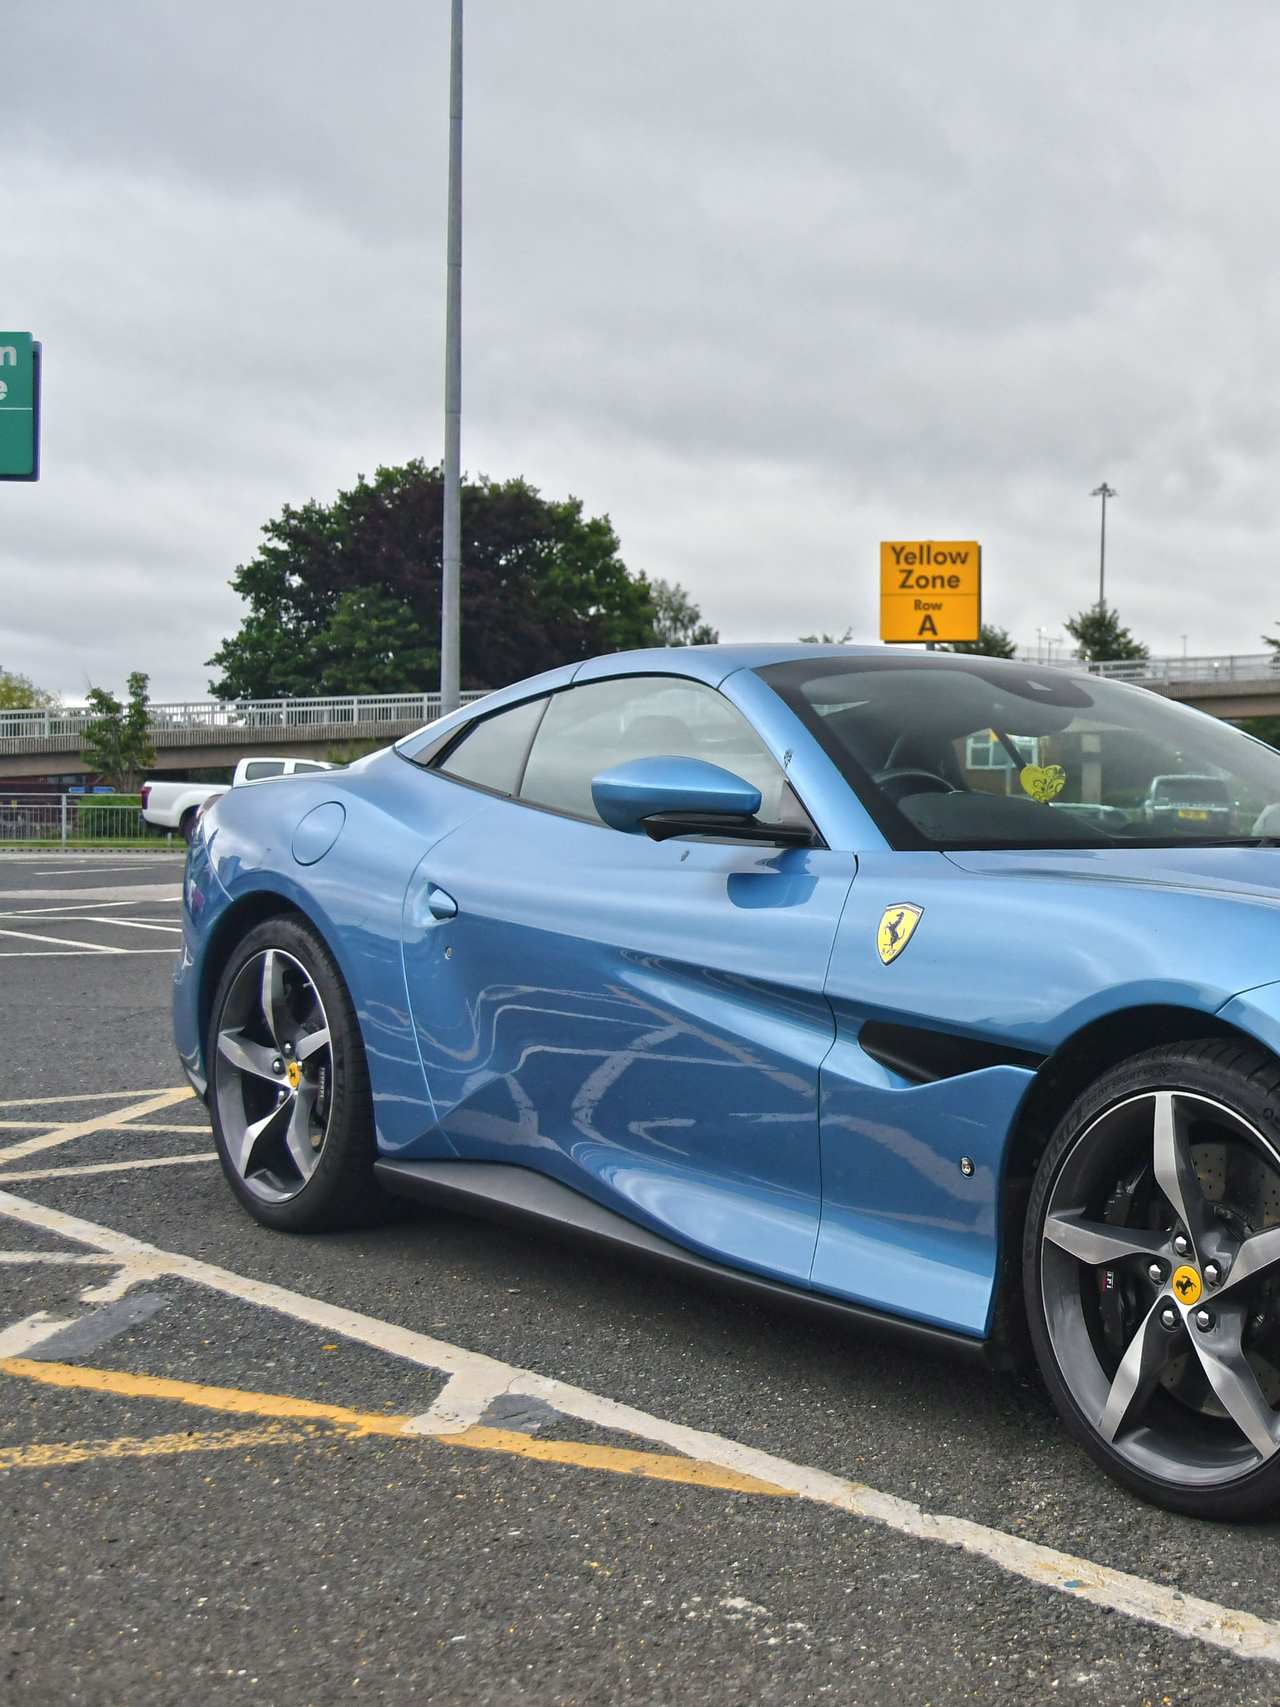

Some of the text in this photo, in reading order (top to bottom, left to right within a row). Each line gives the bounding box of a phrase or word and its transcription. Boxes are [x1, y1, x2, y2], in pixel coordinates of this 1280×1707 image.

[890, 545, 969, 565] Yellow
[898, 569, 961, 589] Zone
[914, 599, 943, 611] Row
[917, 614, 938, 636] A
[1086, 1084, 1109, 1107] PILOT
[1111, 1069, 1141, 1089] SPORT
